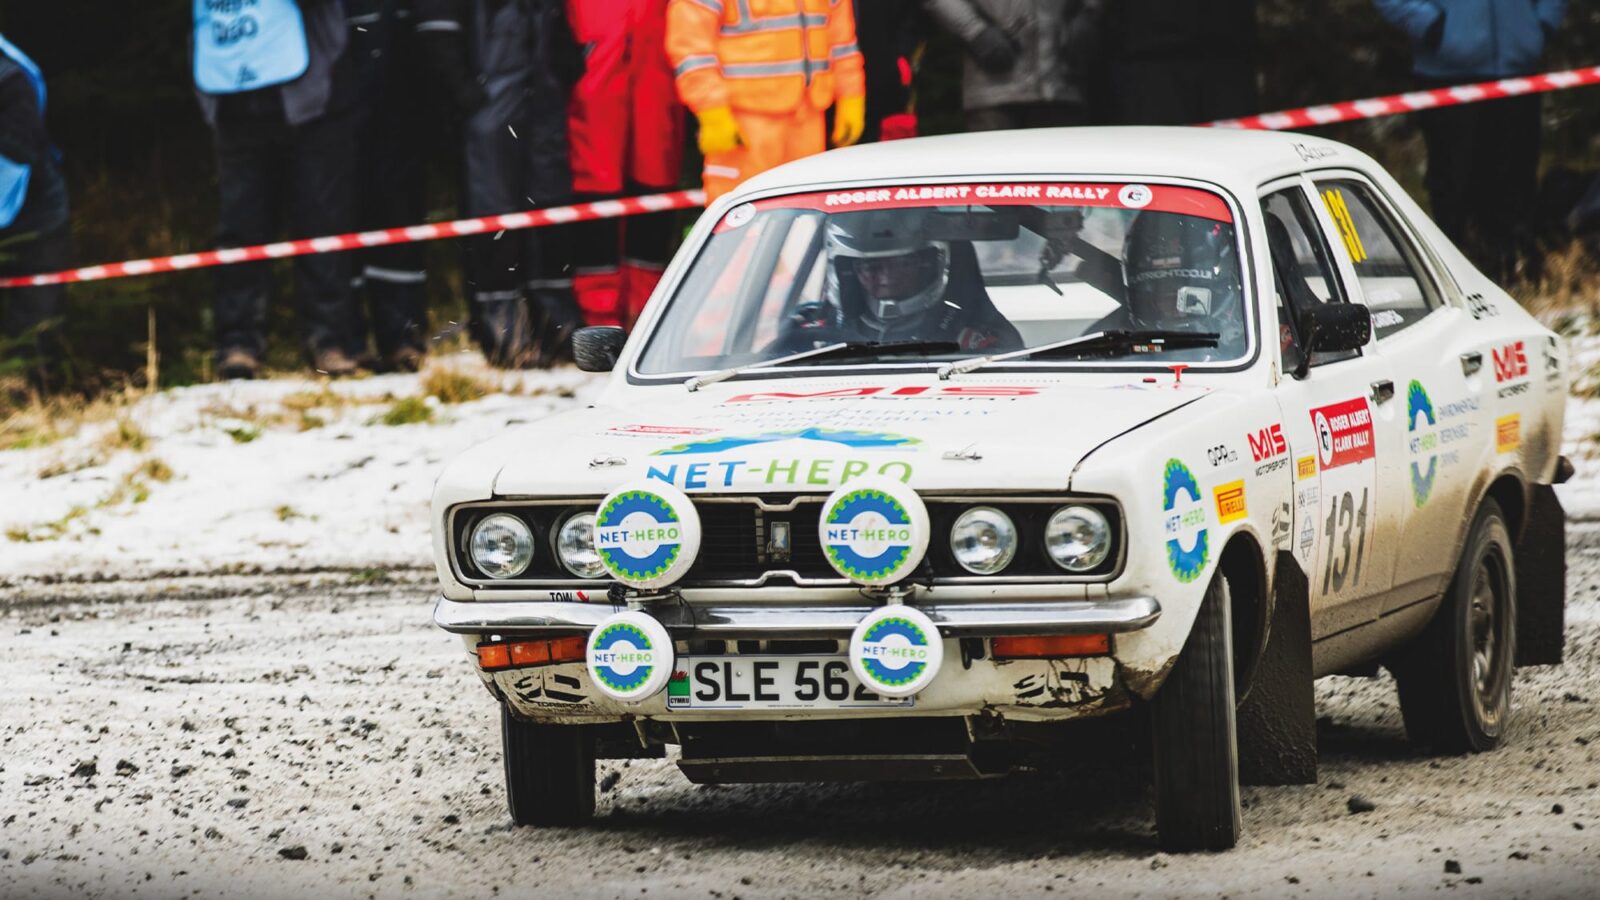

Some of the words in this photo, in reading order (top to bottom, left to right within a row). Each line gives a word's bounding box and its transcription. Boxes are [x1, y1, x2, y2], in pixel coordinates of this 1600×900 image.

[825, 189, 891, 206] ROGER
[894, 186, 971, 200] ALBERT
[975, 185, 1041, 198] CLARK
[1046, 185, 1110, 200] RALLY
[725, 386, 1046, 403] MIS
[1329, 413, 1350, 432] ROGER
[1348, 408, 1371, 428] ALBERT
[1247, 423, 1287, 463] MIS
[1334, 434, 1352, 453] CLARK
[1352, 430, 1369, 449] RALLY
[1217, 487, 1245, 517] PIRELLI
[600, 527, 679, 543] NET-HERO
[828, 528, 911, 542] NET-HERO
[1322, 486, 1368, 596] 131
[549, 592, 573, 602] TOW
[594, 653, 653, 663] NET-HERO
[863, 646, 928, 659] NET-HERO
[695, 661, 780, 701] SLE
[671, 697, 690, 705] CYMRU
